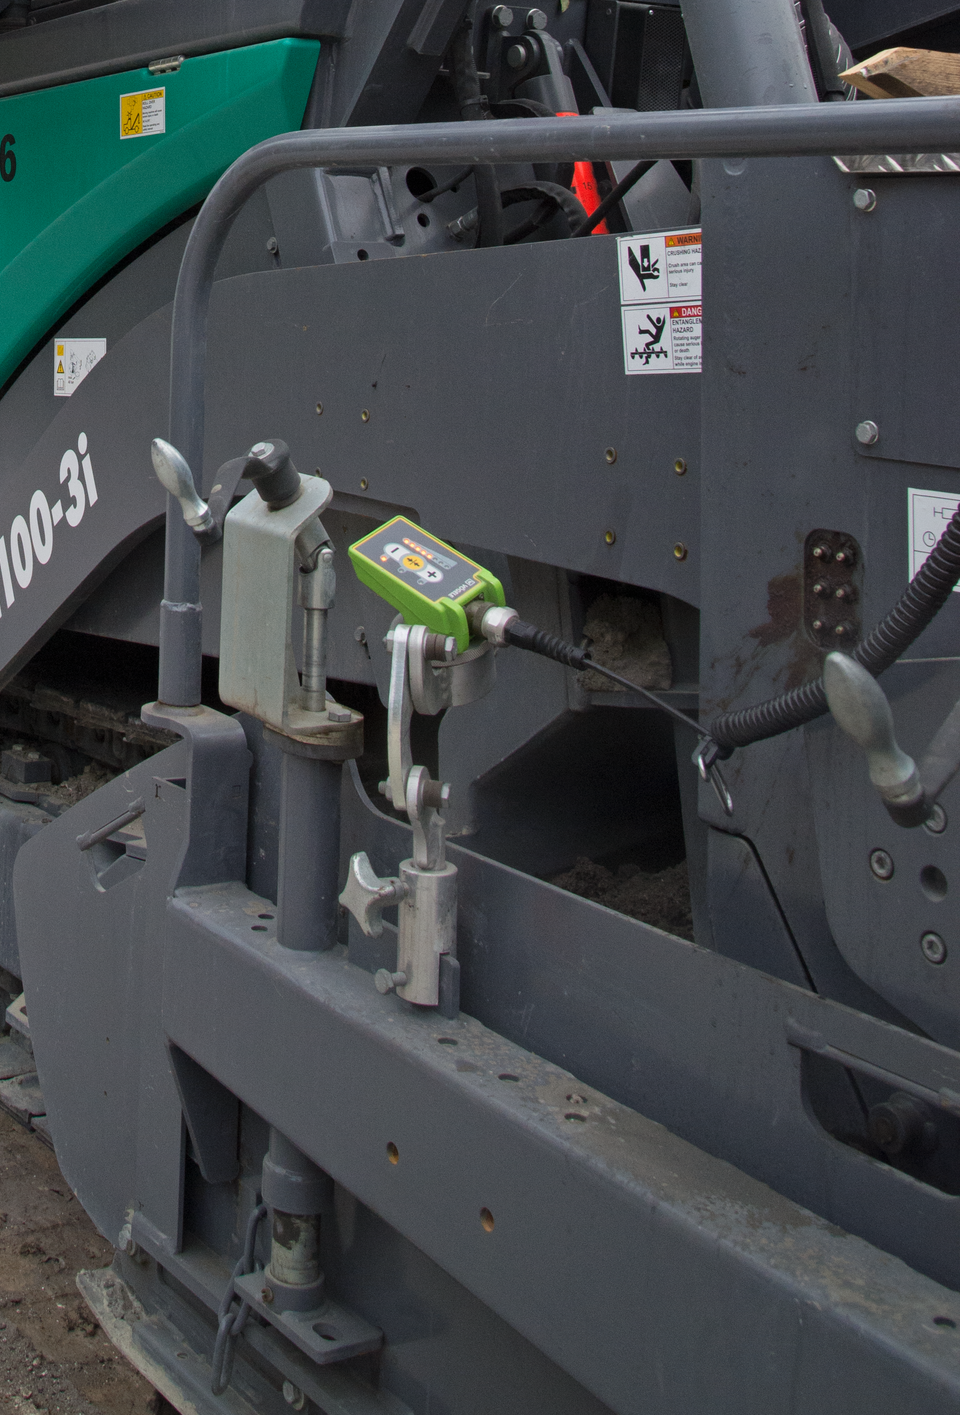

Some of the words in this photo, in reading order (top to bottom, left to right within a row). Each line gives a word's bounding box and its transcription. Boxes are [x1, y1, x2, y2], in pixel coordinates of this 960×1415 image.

[677, 235, 702, 244] WARNI
[667, 248, 691, 256] CRUSHING
[672, 326, 694, 334] HAZARD
